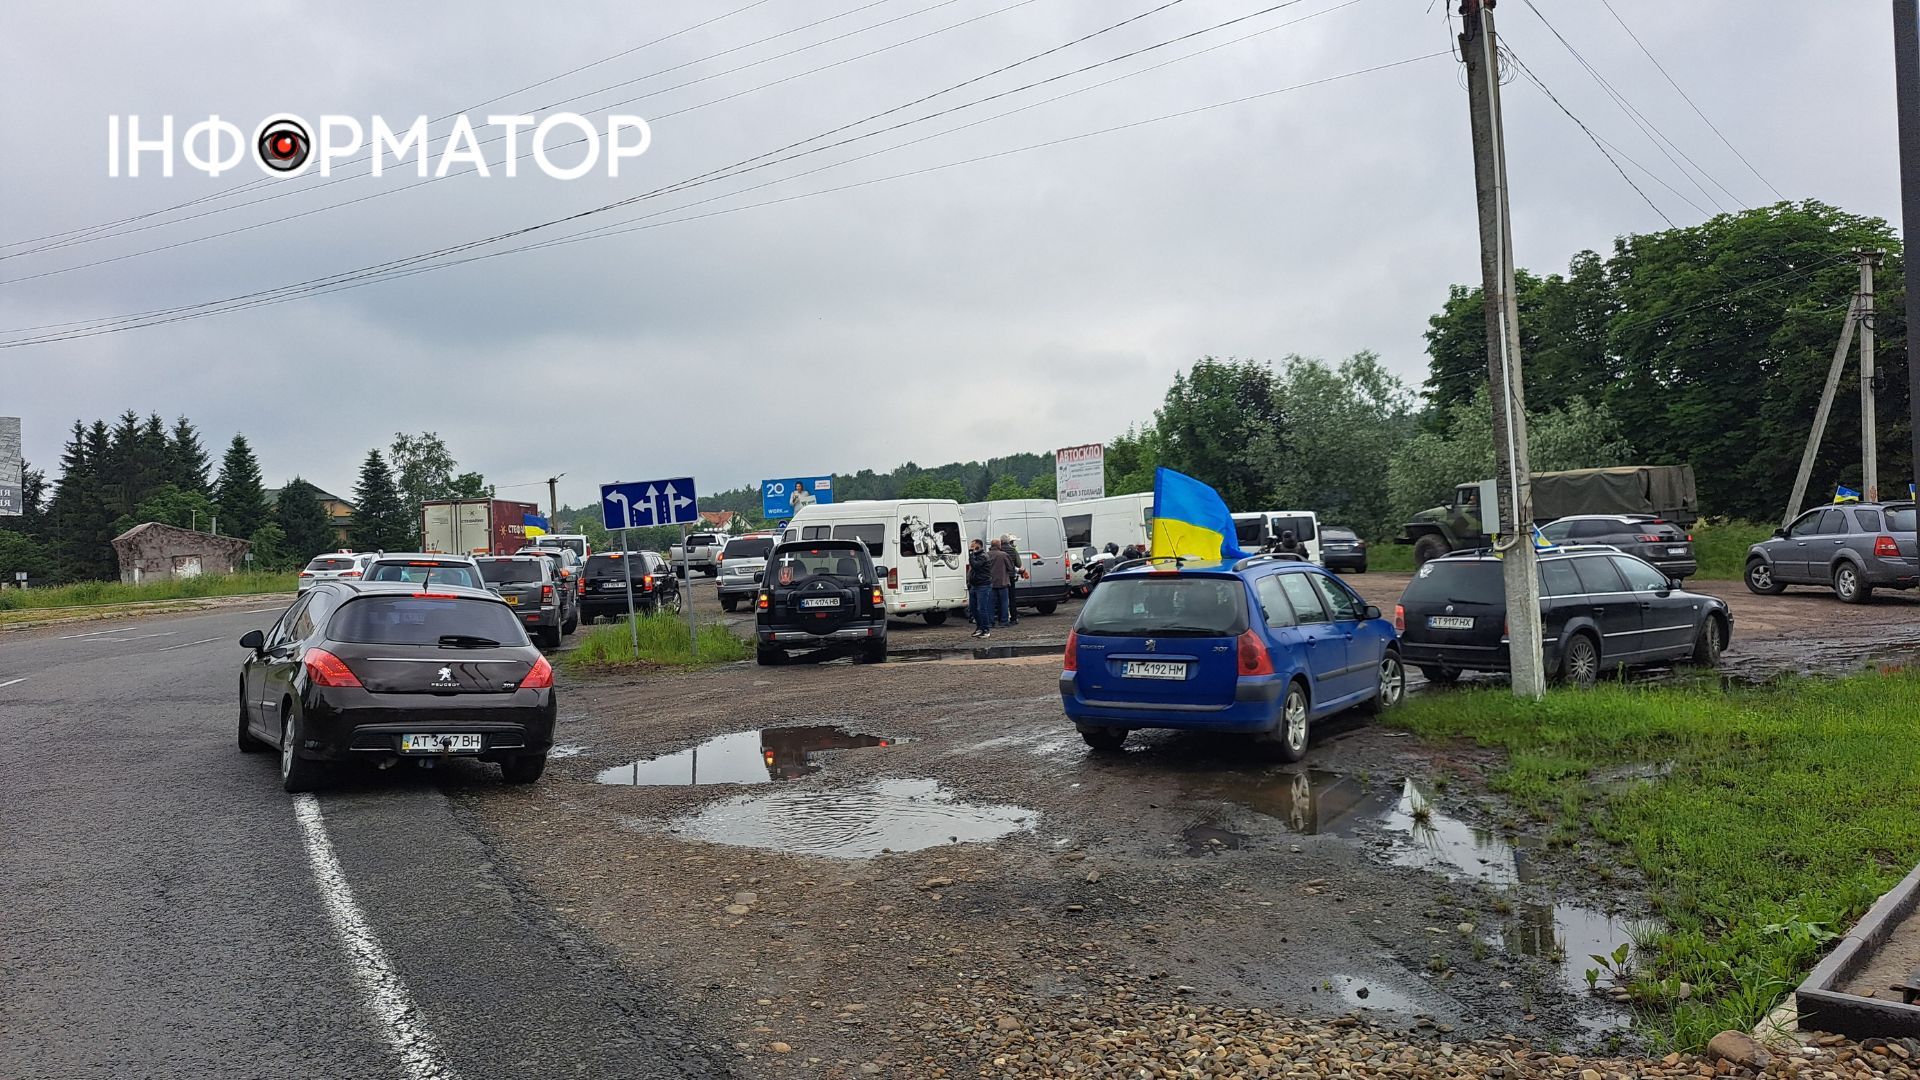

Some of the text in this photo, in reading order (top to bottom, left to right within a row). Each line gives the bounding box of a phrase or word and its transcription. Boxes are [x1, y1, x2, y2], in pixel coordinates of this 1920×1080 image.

[1059, 445, 1100, 462] АВТОСКЛО
[766, 483, 784, 496] 20
[1144, 664, 1166, 675] 4192
